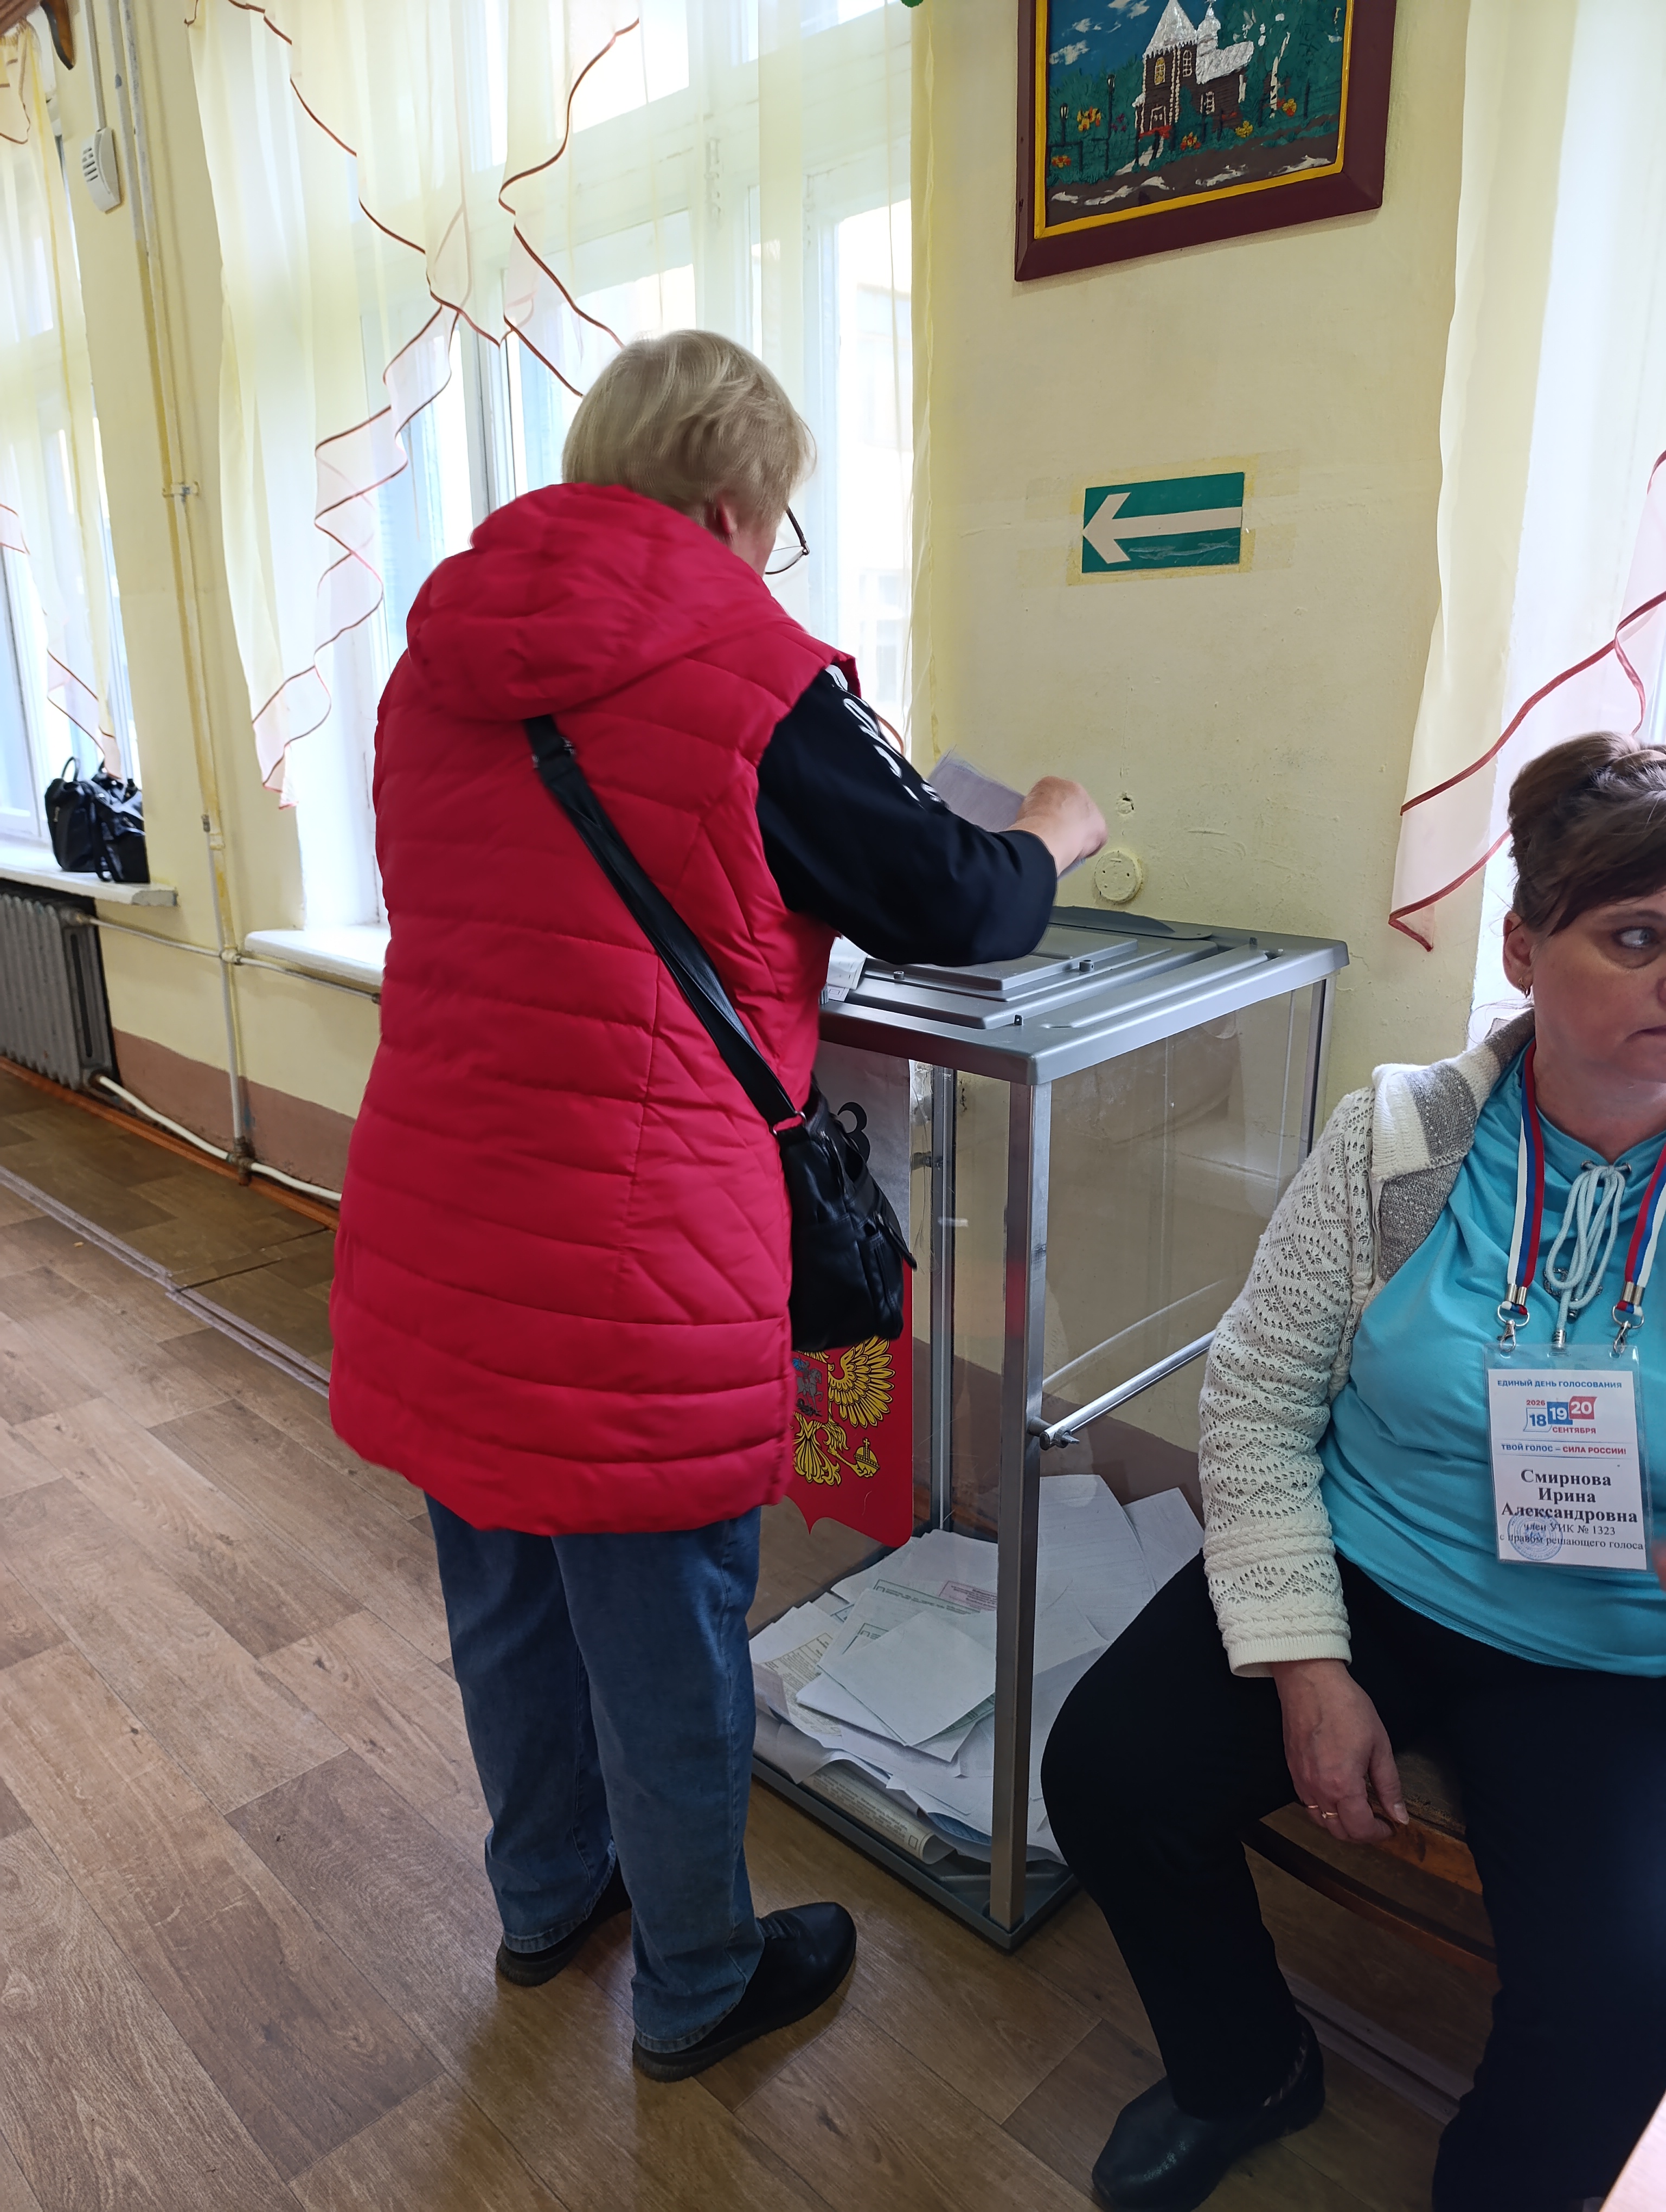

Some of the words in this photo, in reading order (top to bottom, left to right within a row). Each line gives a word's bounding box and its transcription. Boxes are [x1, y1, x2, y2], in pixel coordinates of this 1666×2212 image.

[1549, 1407, 1567, 1420] 19
[1570, 1402, 1592, 1414] 20
[1529, 1414, 1547, 1426] 18
[1521, 1469, 1611, 1488] Смирнова
[1539, 1487, 1595, 1504] Ирина
[1501, 1503, 1637, 1523] Александровна
[1550, 1524, 1574, 1533] УИК
[1577, 1526, 1589, 1534] №
[1592, 1526, 1615, 1535] 1323
[1508, 1535, 1543, 1544] правом
[1546, 1538, 1606, 1548] решающего
[1610, 1542, 1643, 1550] голоса
